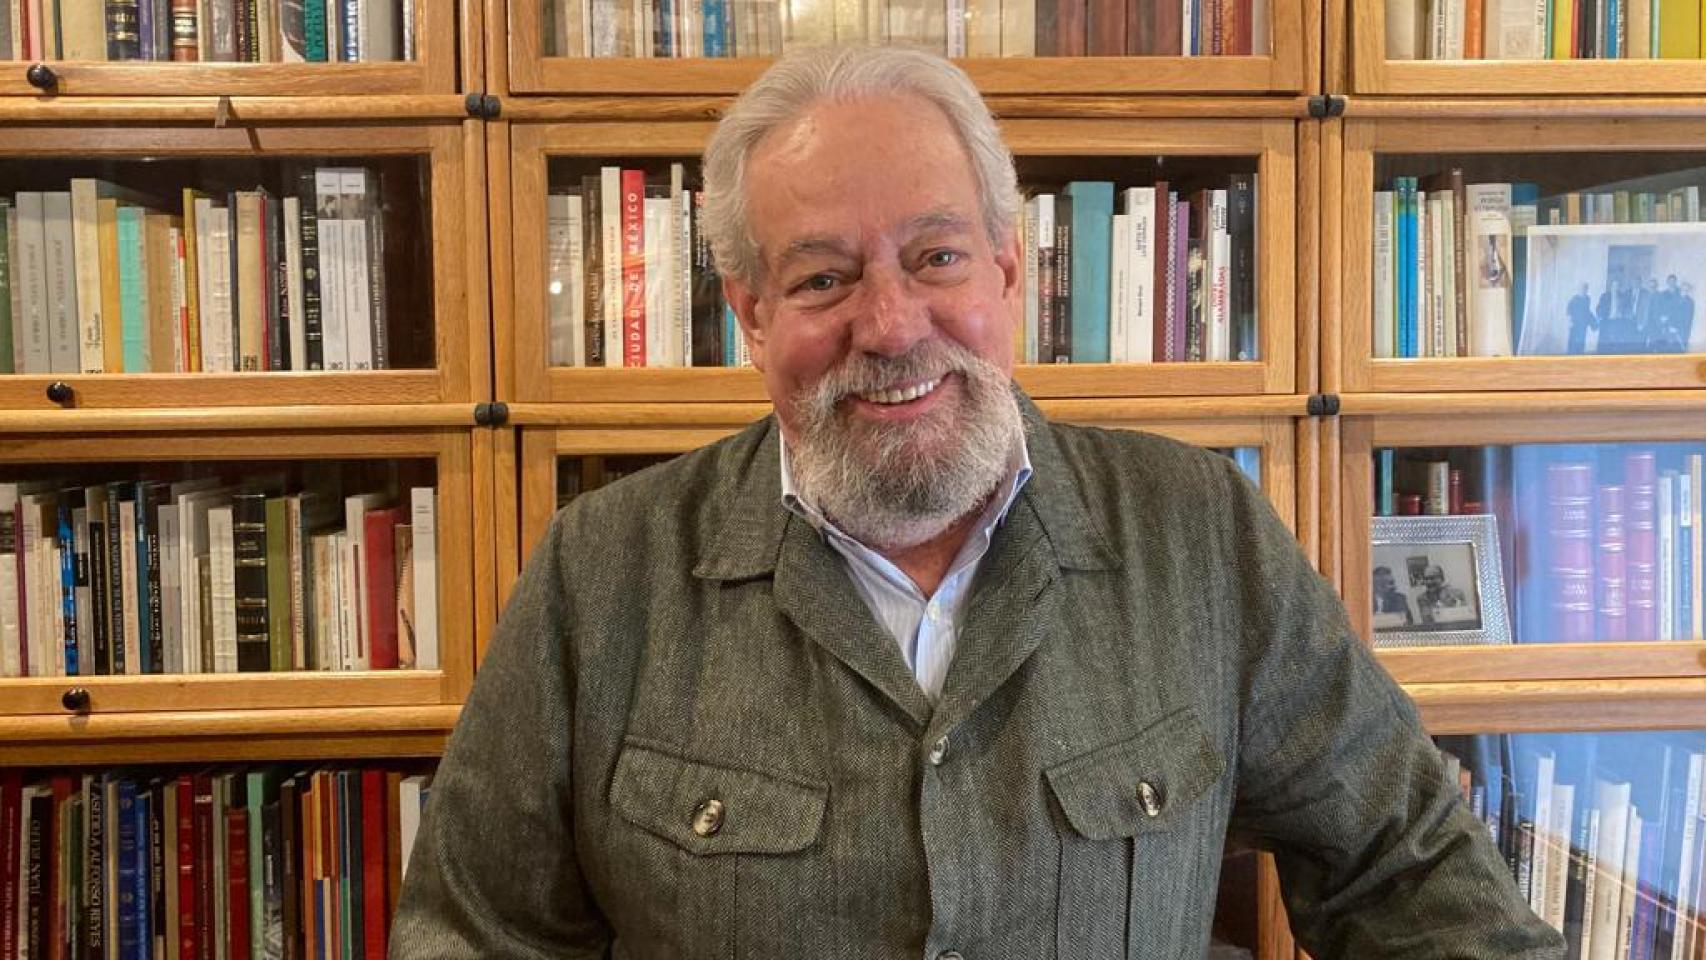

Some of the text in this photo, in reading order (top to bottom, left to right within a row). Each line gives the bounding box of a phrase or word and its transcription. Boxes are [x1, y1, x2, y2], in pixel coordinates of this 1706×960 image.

[627, 192, 641, 367] CIUDAD DE MÉXICO
[91, 793, 101, 836] ASEDIO
[91, 849, 101, 906] ALFONSO
[90, 908, 100, 948] REYES
